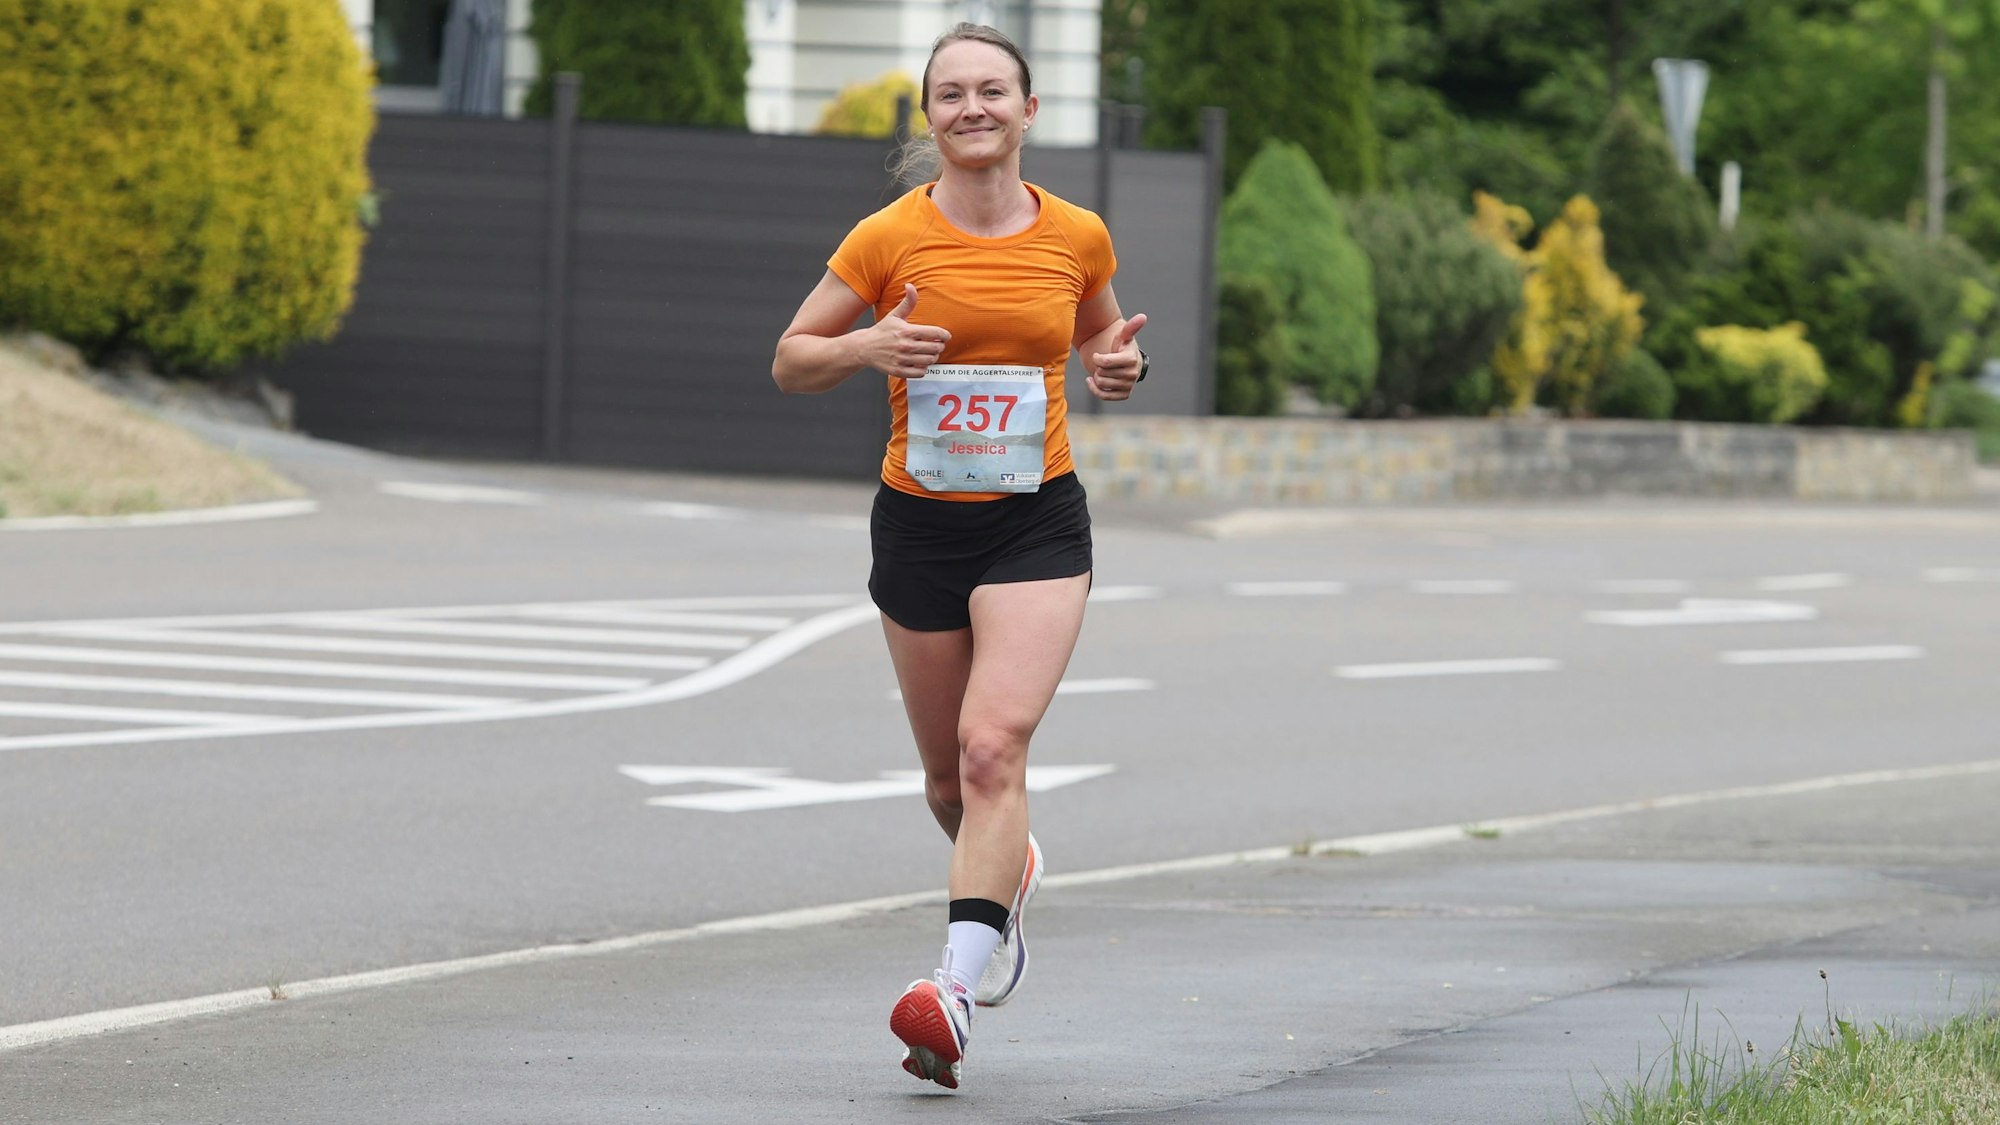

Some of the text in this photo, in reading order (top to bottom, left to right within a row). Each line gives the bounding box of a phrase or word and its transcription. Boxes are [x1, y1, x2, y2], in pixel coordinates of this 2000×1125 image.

[972, 368, 1033, 376] AGGERTALSPERRE
[937, 394, 1018, 432] 257
[947, 441, 1007, 454] Jessica
[914, 469, 942, 477] BOHLE
